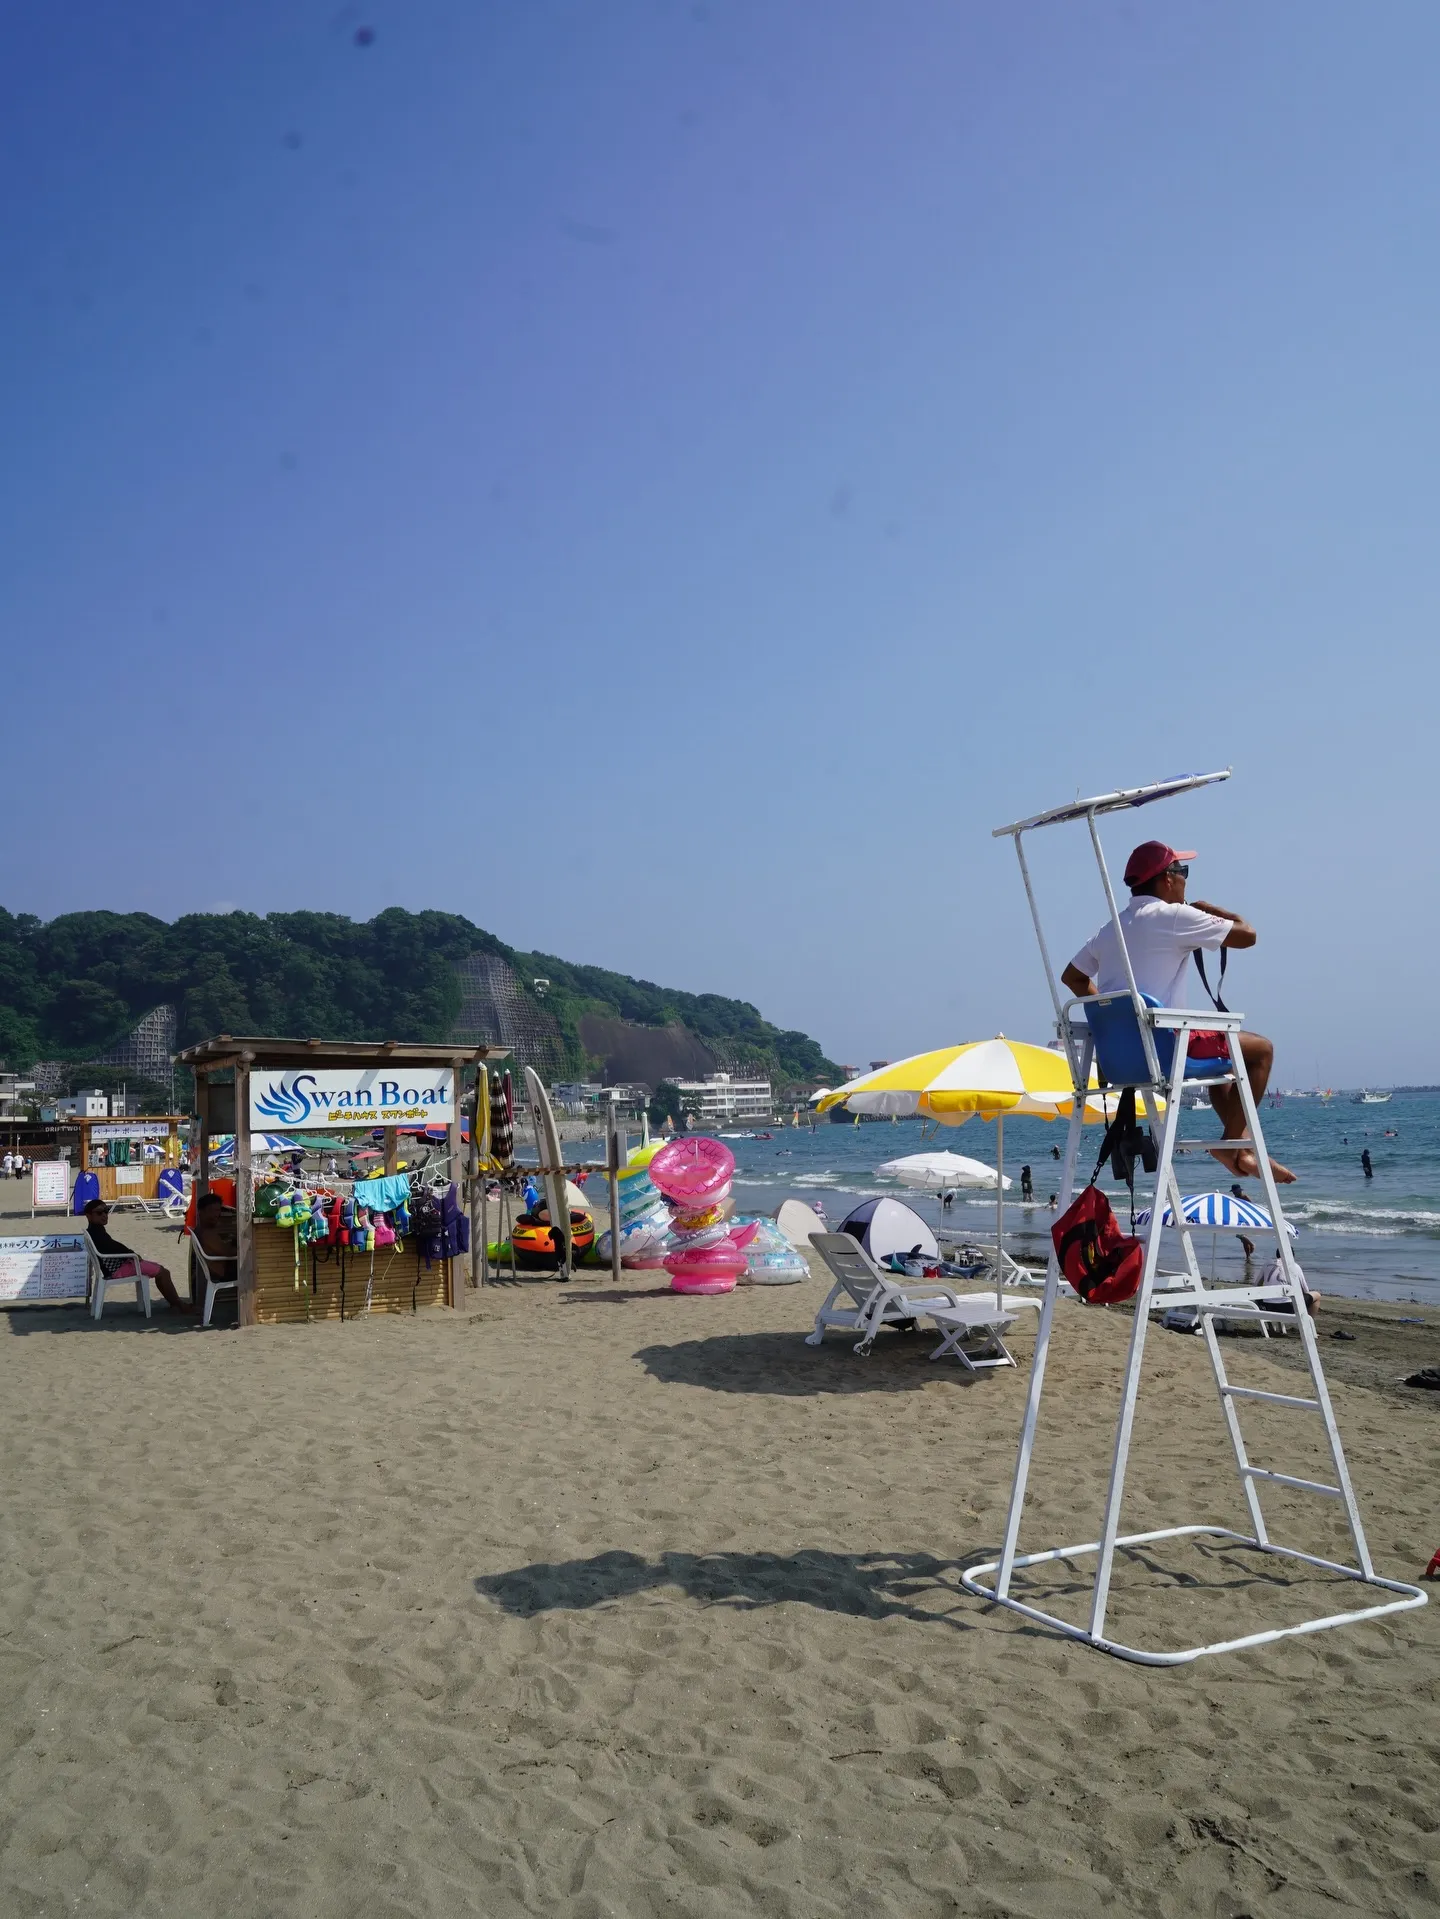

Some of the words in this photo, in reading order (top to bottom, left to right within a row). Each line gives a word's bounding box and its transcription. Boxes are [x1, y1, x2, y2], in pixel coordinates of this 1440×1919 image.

[379, 1081, 448, 1106] Boat
[381, 1107, 428, 1120] スワンボート
[18, 1238, 81, 1250] スワンボート
